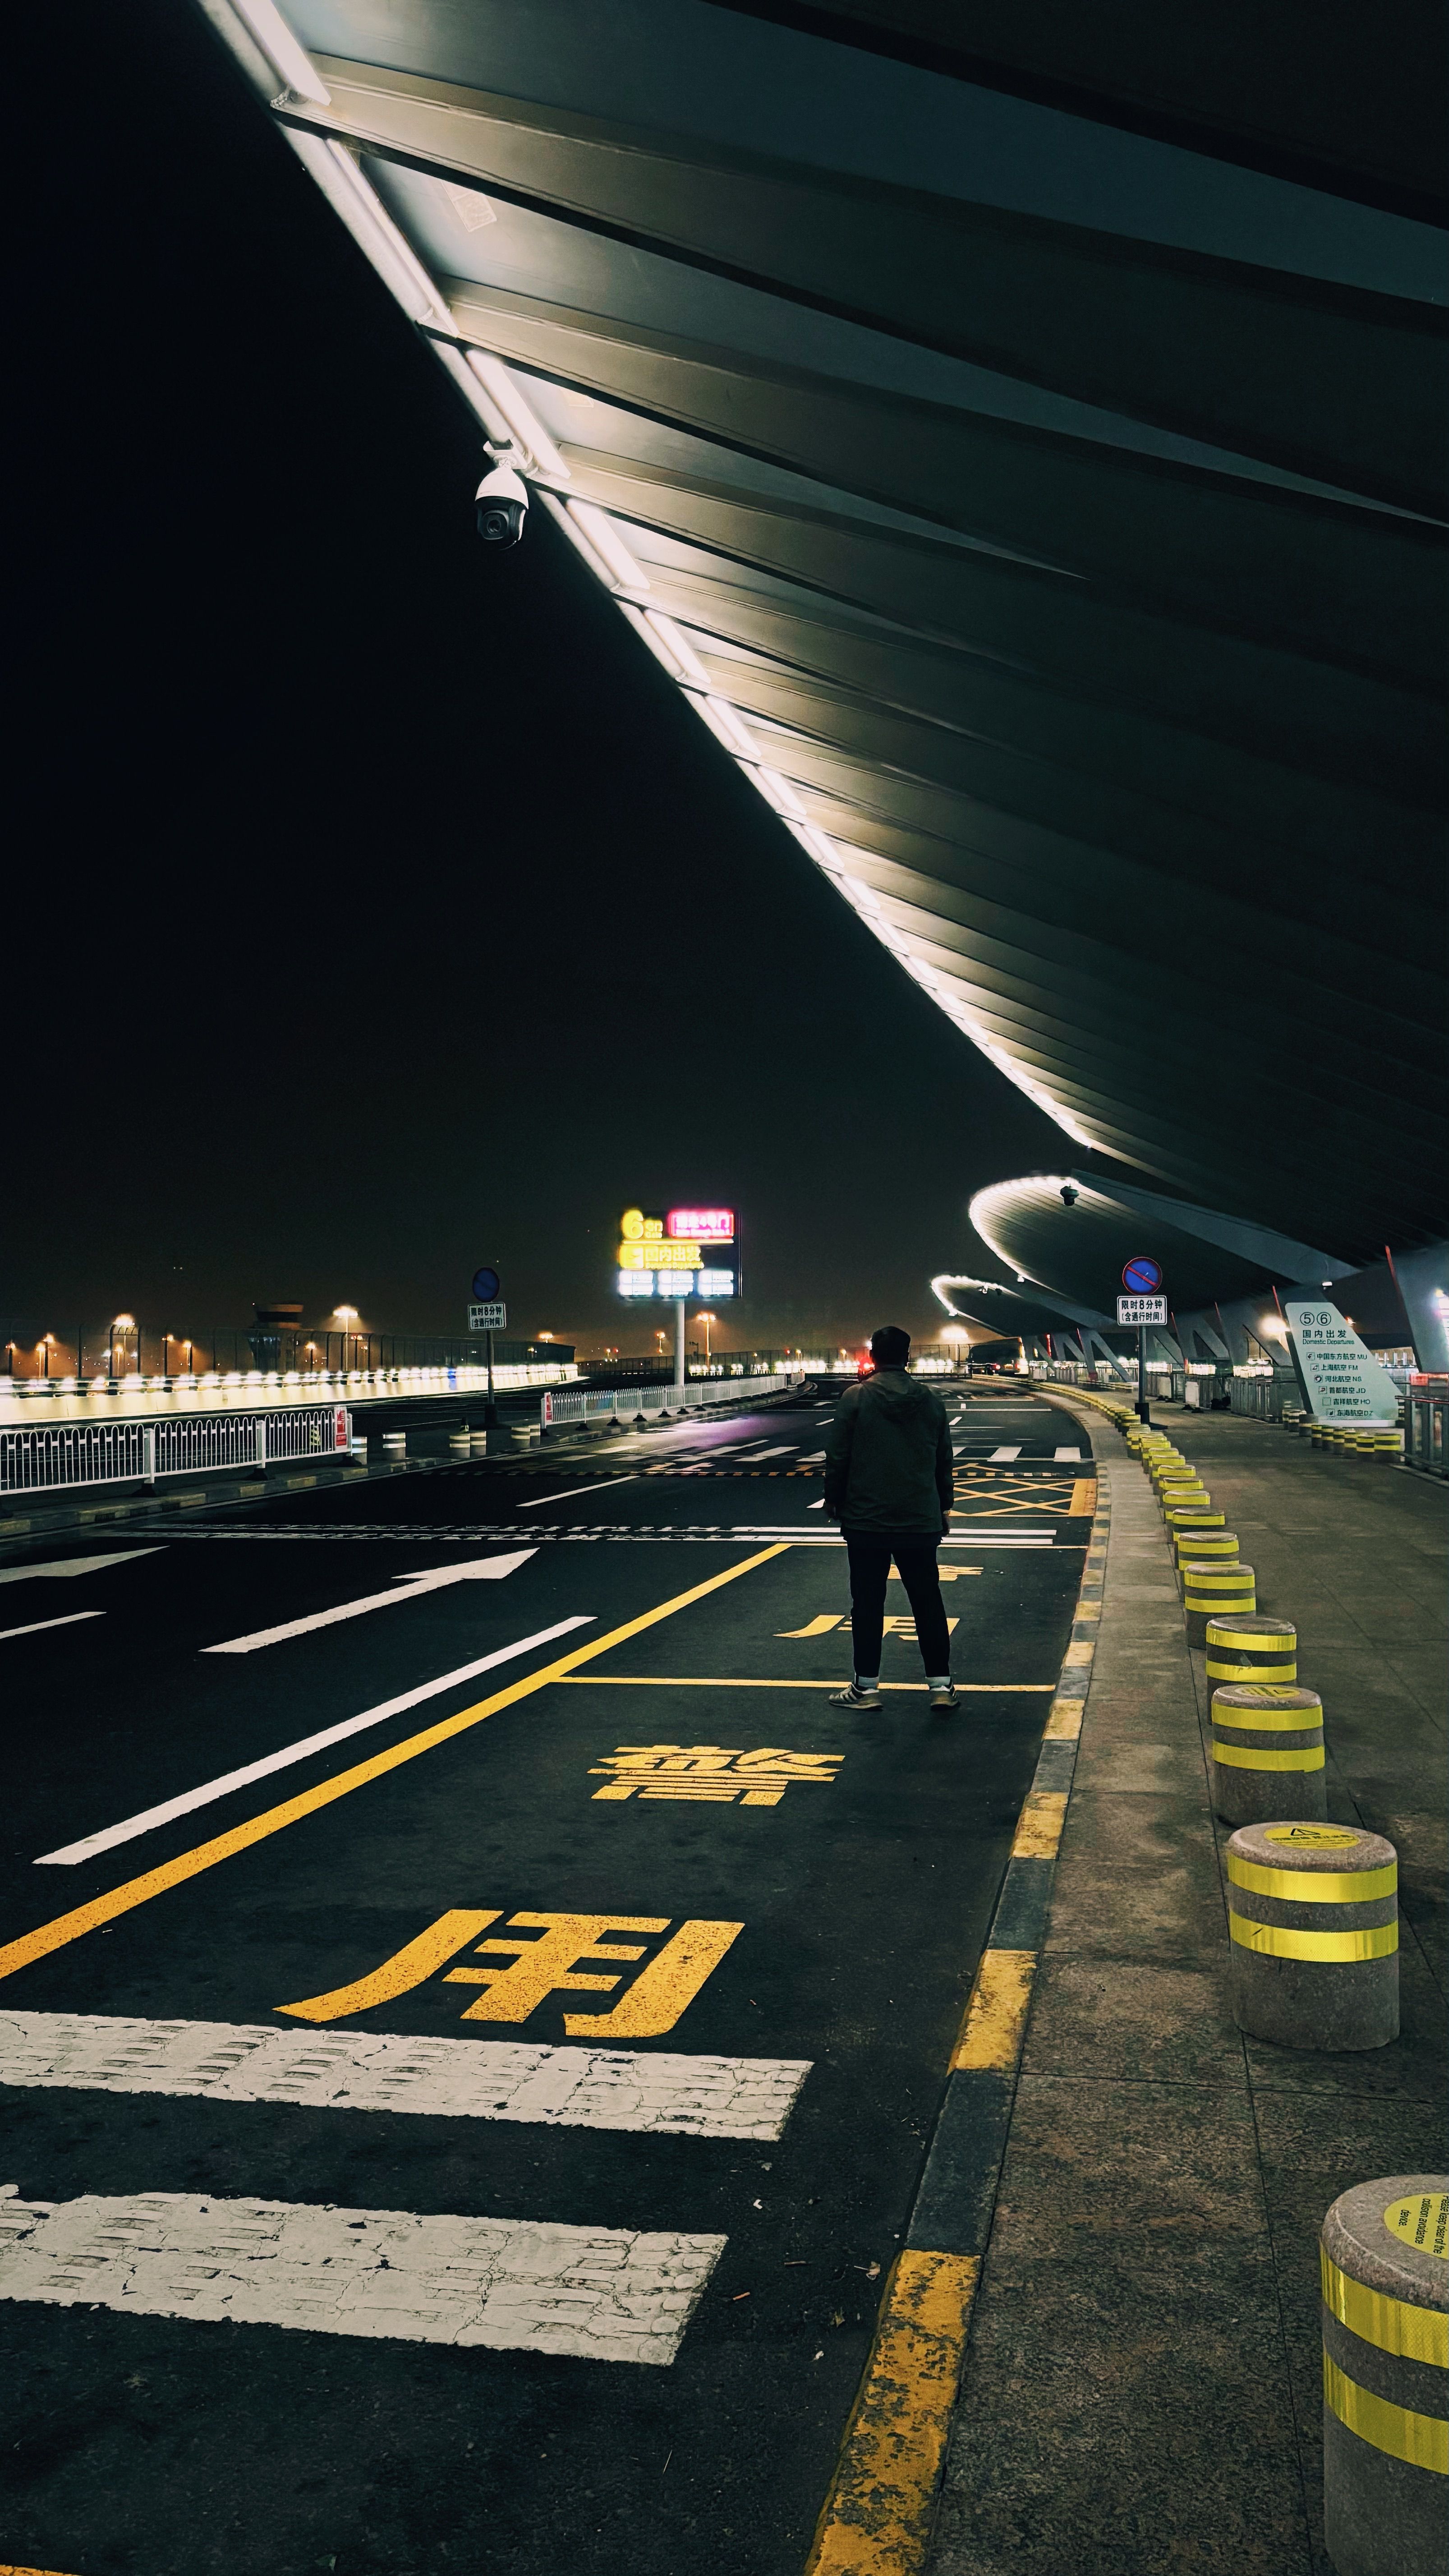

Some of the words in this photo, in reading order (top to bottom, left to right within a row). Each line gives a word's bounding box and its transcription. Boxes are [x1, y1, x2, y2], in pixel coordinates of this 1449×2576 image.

[622, 1210, 644, 1239] 6
[645, 1246, 701, 1262] 国内出发
[1122, 1300, 1162, 1310] 限时8分钟
[1122, 1311, 1162, 1322] (含通行时间)
[1302, 1329, 1346, 1338] 国内出发
[1435, 2213, 1449, 2225] keep
[1414, 2218, 1428, 2245] avoidance
[1436, 2226, 1447, 2238] clear
[1433, 2245, 1445, 2254] the
